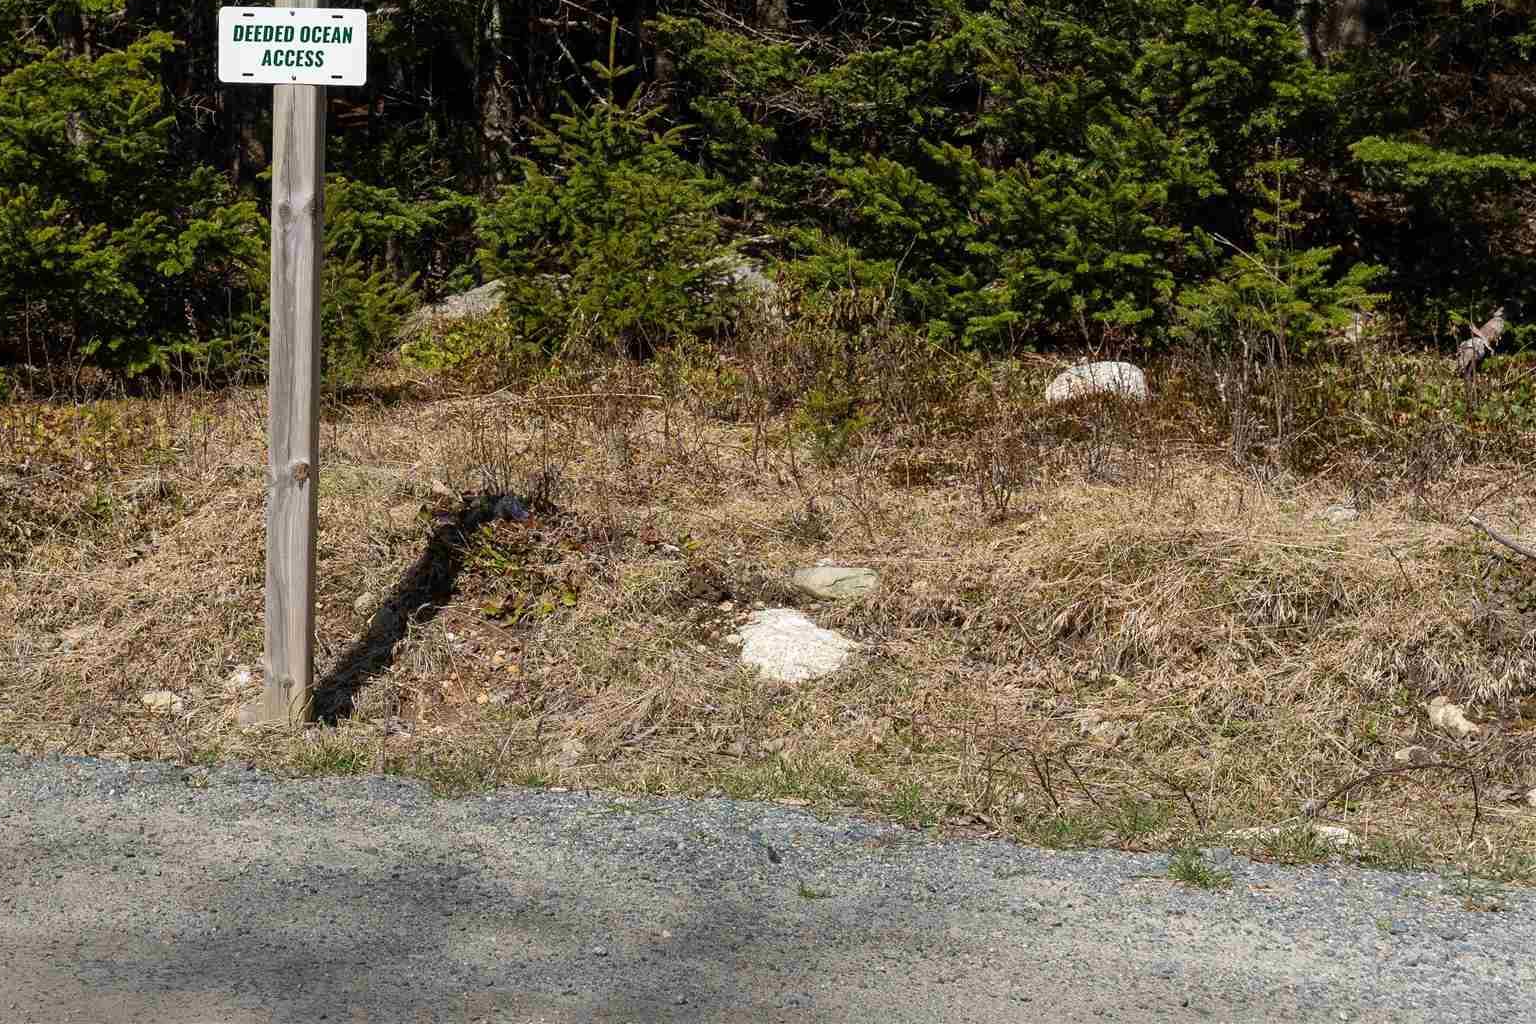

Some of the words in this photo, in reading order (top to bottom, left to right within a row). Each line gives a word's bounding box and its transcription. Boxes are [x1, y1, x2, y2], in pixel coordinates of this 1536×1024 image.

[233, 25, 294, 42] DEEDED
[300, 26, 353, 44] OCEAN
[261, 49, 324, 67] ACCESS
